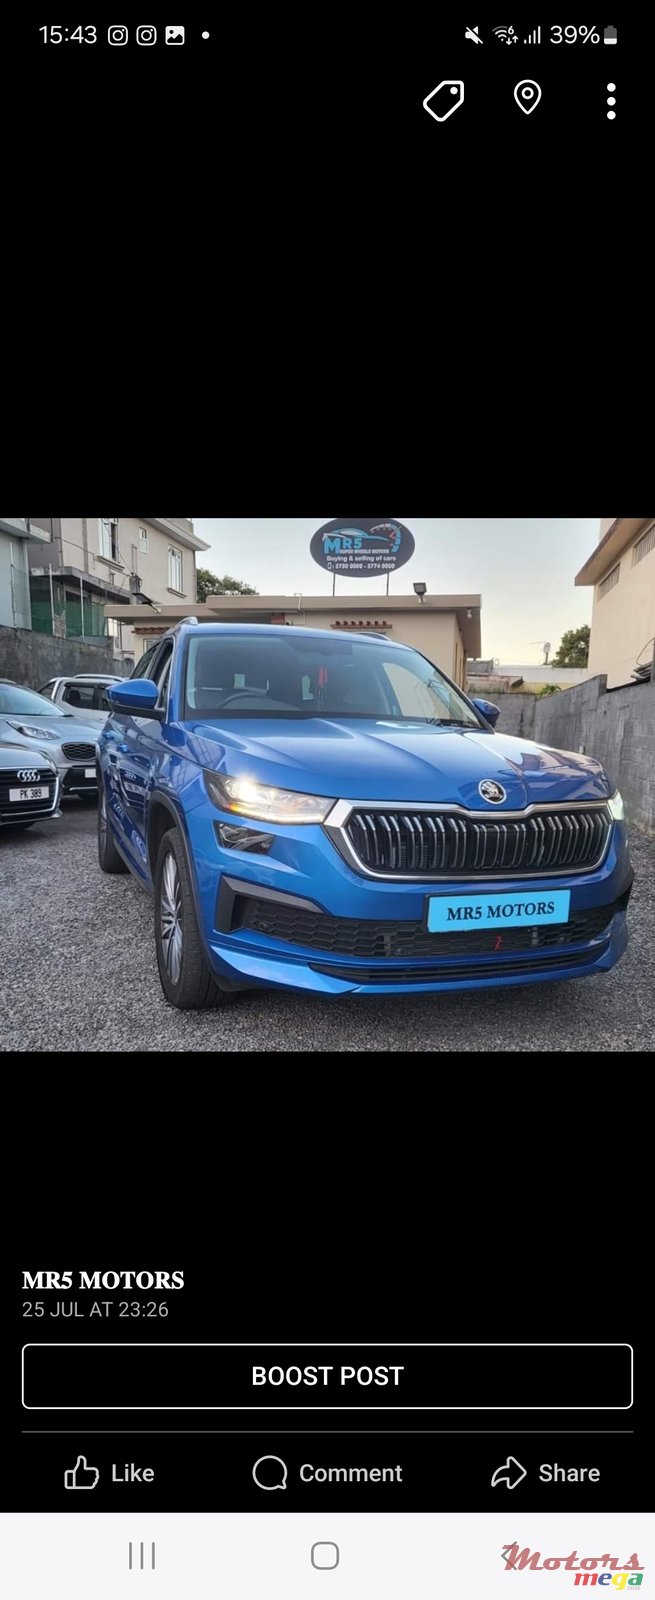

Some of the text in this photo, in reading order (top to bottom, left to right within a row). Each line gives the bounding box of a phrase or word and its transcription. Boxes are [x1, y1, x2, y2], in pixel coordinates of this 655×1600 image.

[39, 26, 97, 43] 15:43
[550, 25, 600, 44] 39%
[324, 537, 362, 554] MR5
[20, 788, 42, 799] PK 389
[447, 901, 555, 921] MR5 MOTORS
[22, 1271, 185, 1290] MR5 MOTORS
[22, 1302, 168, 1317] 25 JUL AT 23:26
[252, 1366, 404, 1385] BOOST POST
[112, 1463, 154, 1482] Like
[300, 1464, 402, 1482] Comment
[539, 1463, 600, 1482] Share
